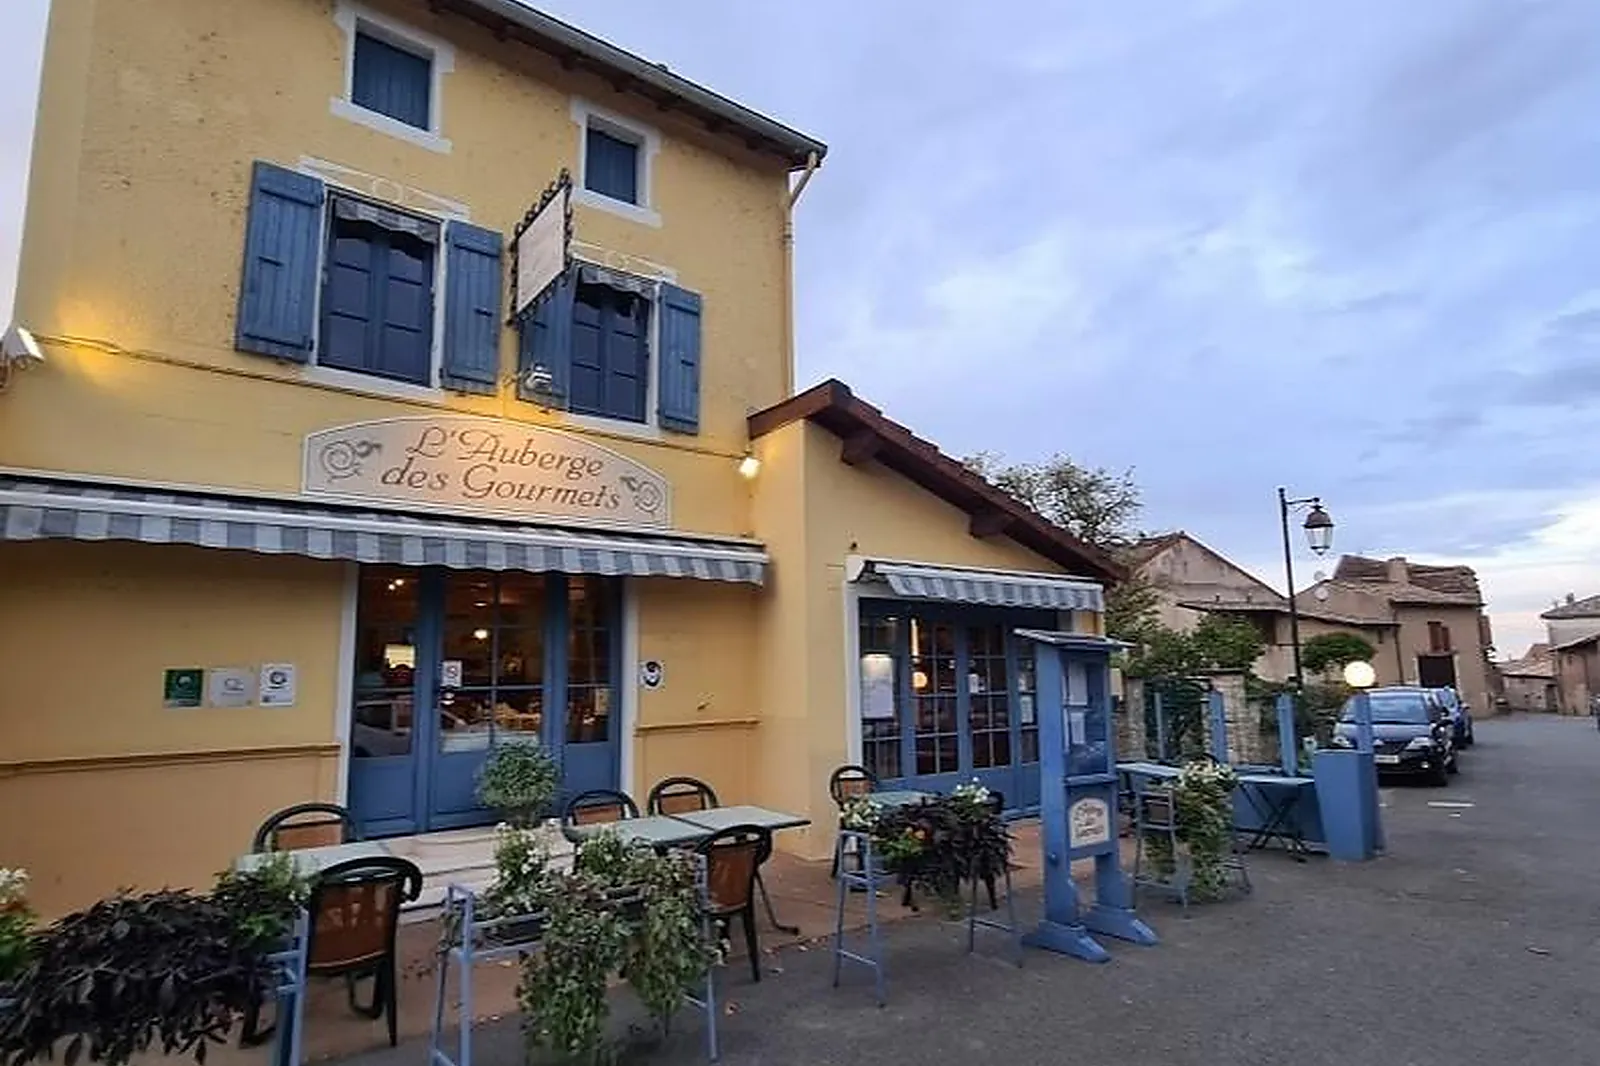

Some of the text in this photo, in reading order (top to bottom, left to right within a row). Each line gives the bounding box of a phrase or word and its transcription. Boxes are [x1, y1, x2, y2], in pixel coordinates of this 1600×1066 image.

[405, 426, 604, 480] L'Auberge
[381, 457, 621, 510] des Gourmets
